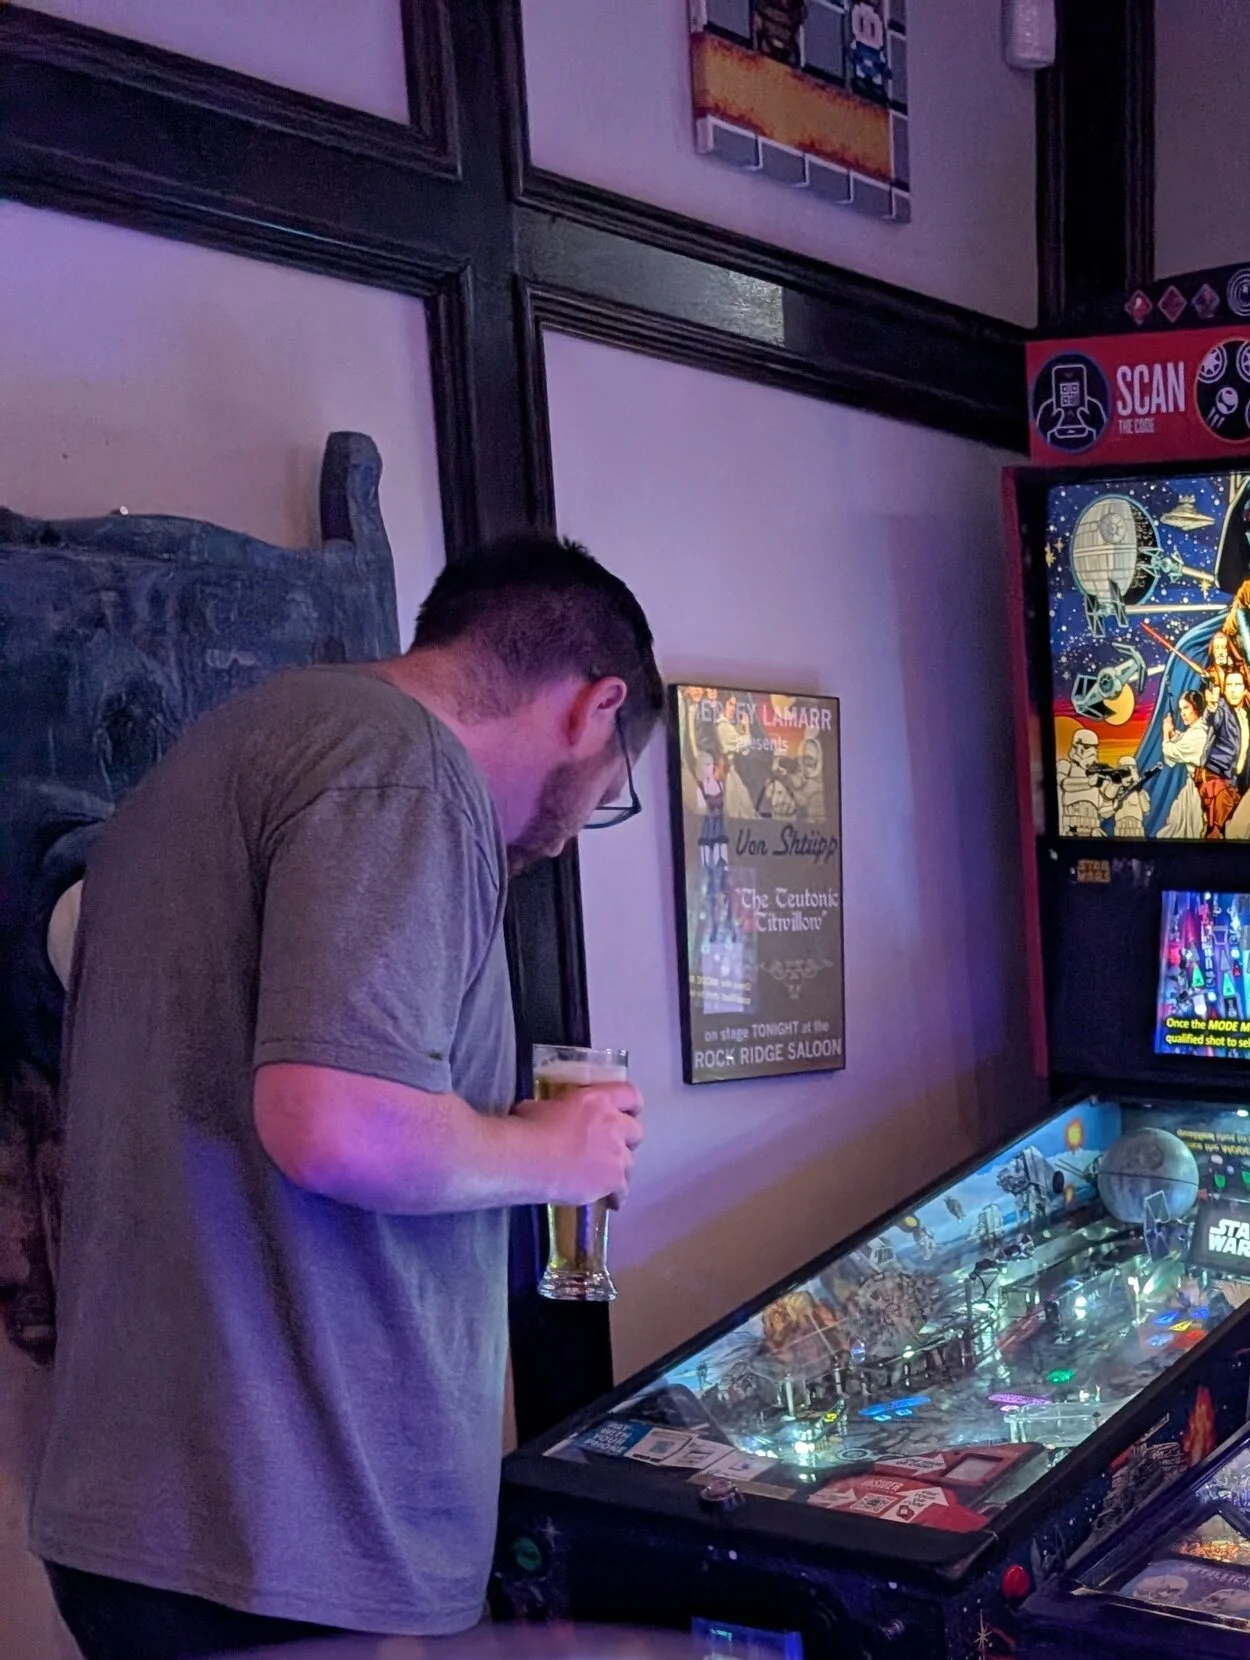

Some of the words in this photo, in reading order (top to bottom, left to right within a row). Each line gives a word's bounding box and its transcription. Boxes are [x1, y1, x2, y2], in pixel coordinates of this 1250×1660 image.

[1116, 361, 1186, 417] SCAN
[1119, 419, 1134, 434] THE
[763, 704, 832, 730] LAMARR
[736, 828, 768, 856] Von
[775, 886, 840, 908] Teutonic
[704, 1030, 718, 1042] on
[720, 1027, 748, 1042] stage
[752, 1021, 799, 1038] TONIGHT
[813, 1019, 830, 1032] the
[1166, 1018, 1189, 1029] Once
[1191, 1020, 1207, 1030] the
[1208, 1020, 1238, 1032] MODE
[1165, 1033, 1204, 1045] qualified
[1205, 1035, 1225, 1046] shot
[1227, 1037, 1237, 1047] to
[695, 1049, 735, 1068] ROCK
[740, 1044, 784, 1064] RIDGE
[788, 1039, 842, 1059] SALOON
